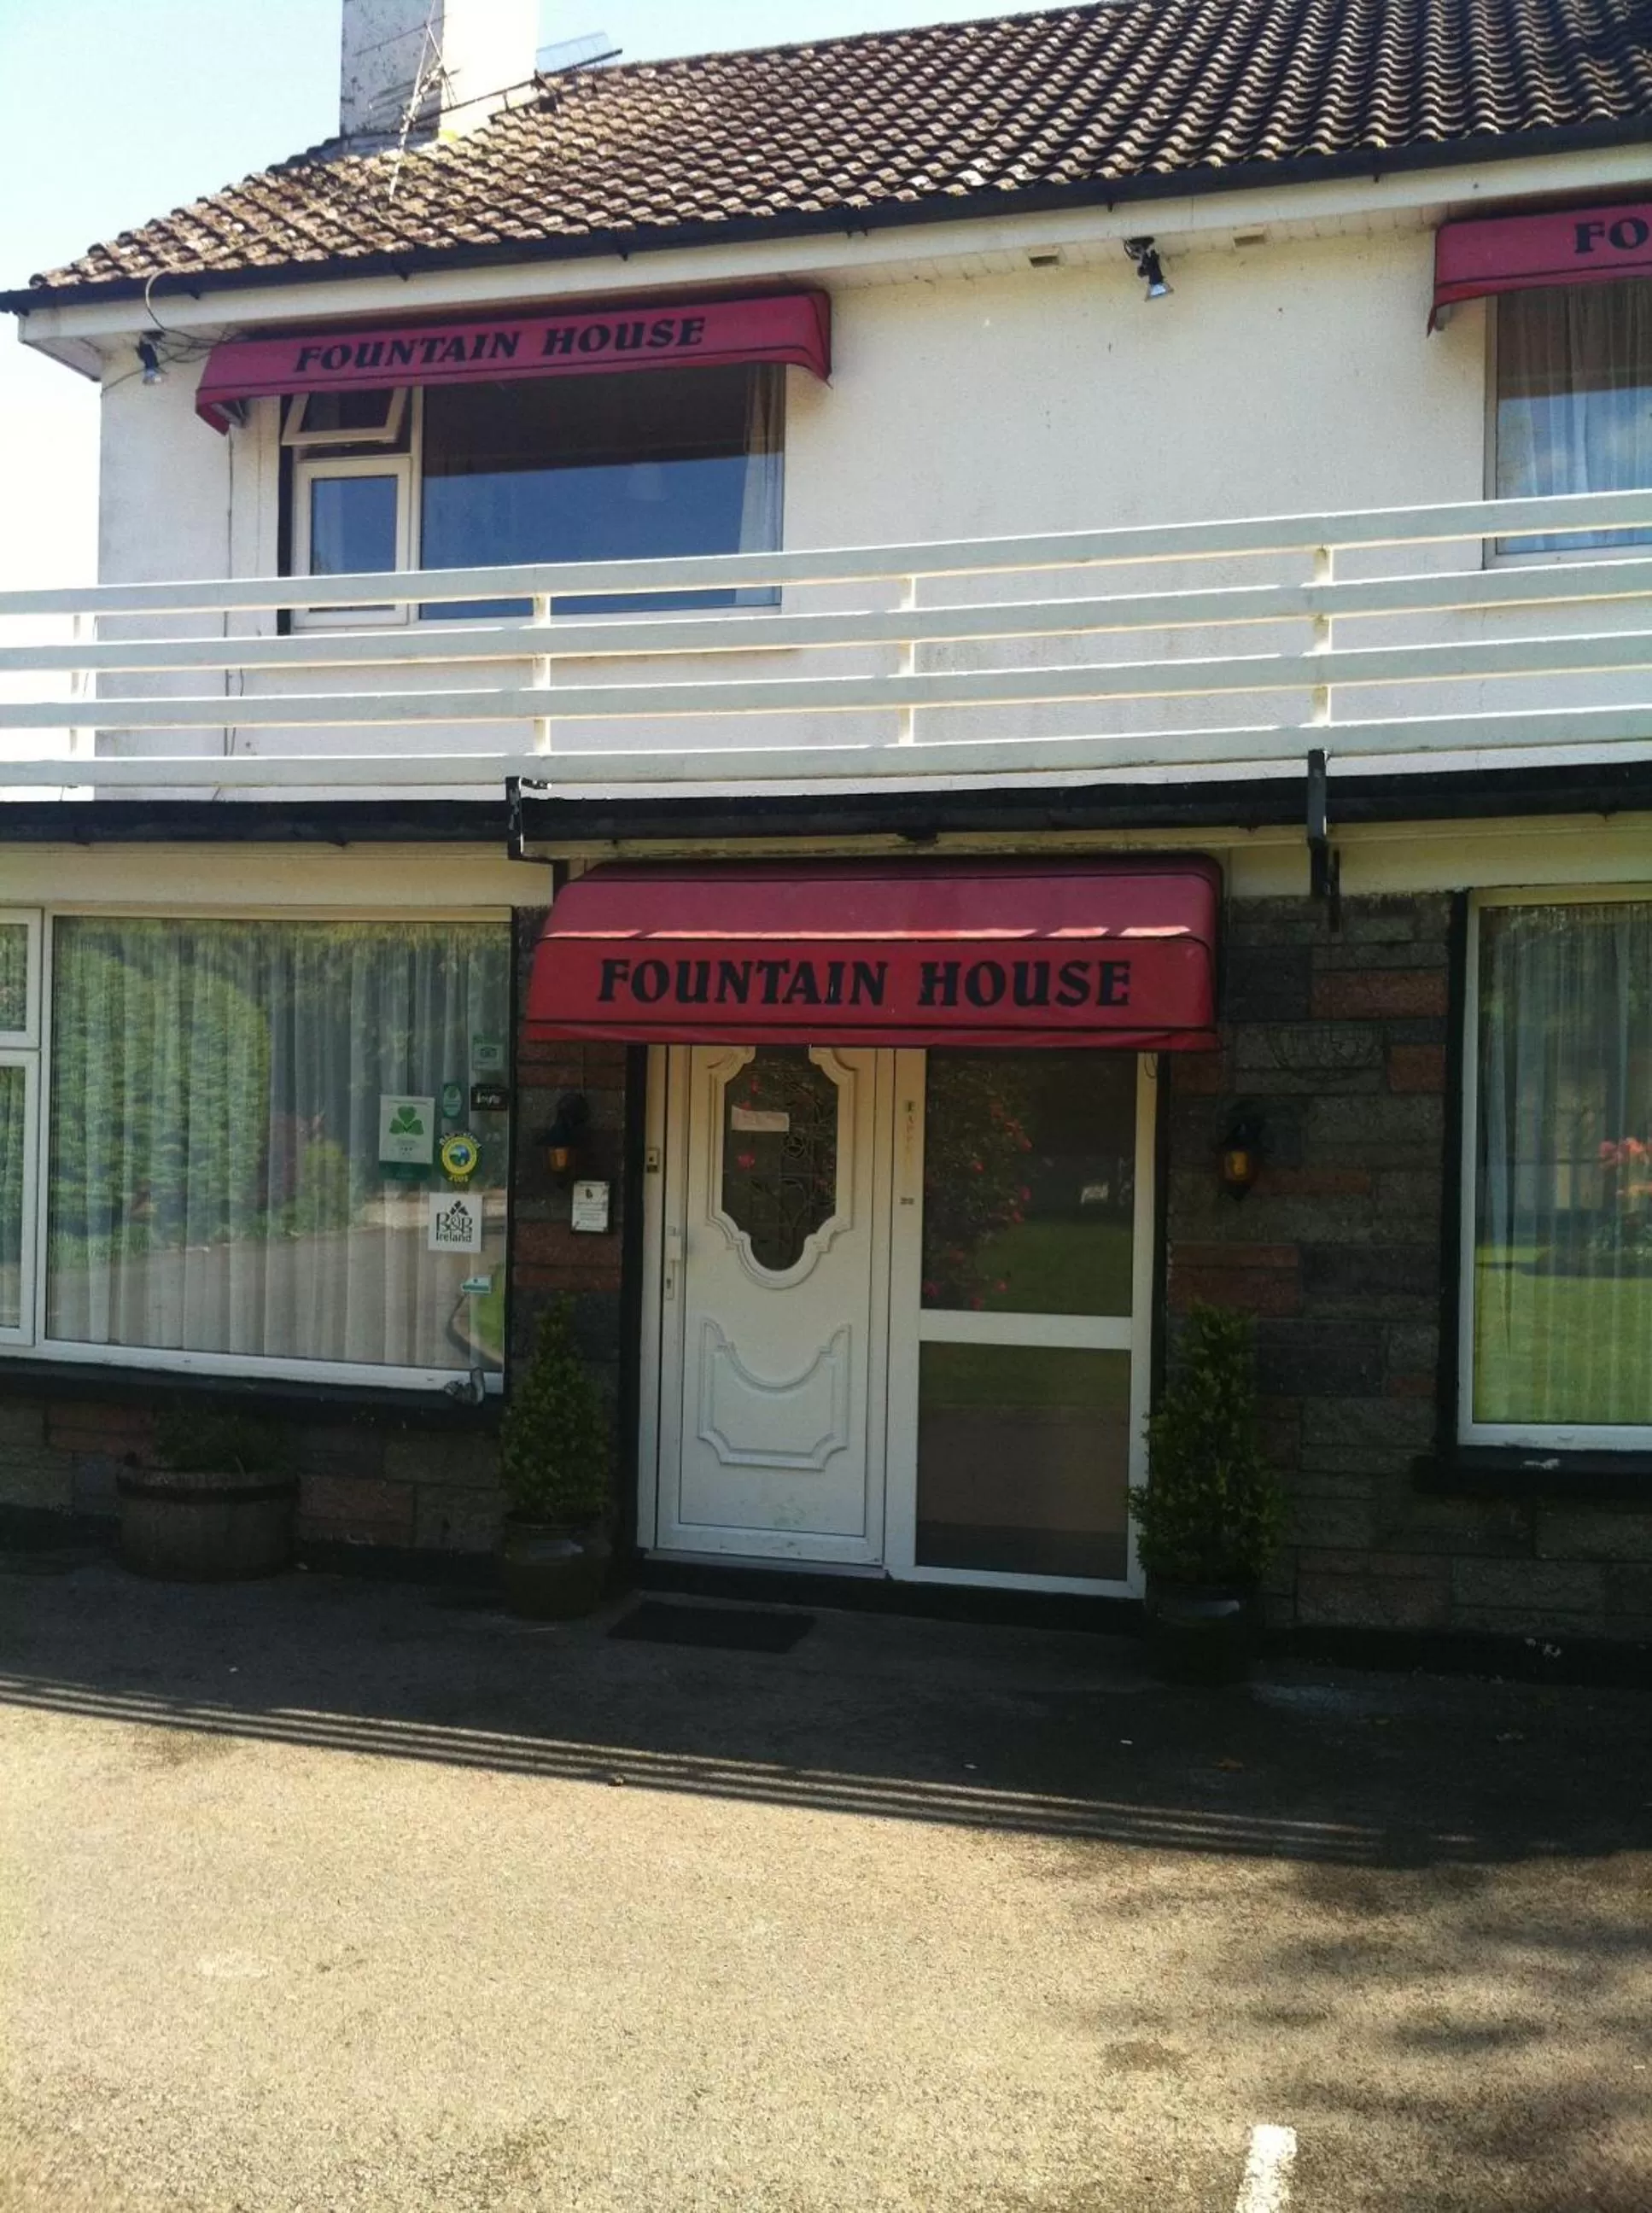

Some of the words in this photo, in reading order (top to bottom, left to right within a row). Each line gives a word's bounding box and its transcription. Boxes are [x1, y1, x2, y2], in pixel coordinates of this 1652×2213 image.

[295, 330, 520, 372] FOUNTAIN
[541, 317, 706, 355] HOUSE
[597, 959, 888, 1005] FOUNTAIN
[917, 961, 1131, 1007] HOUSE
[436, 1213, 473, 1234] B&B
[436, 1231, 472, 1242] Ireland
